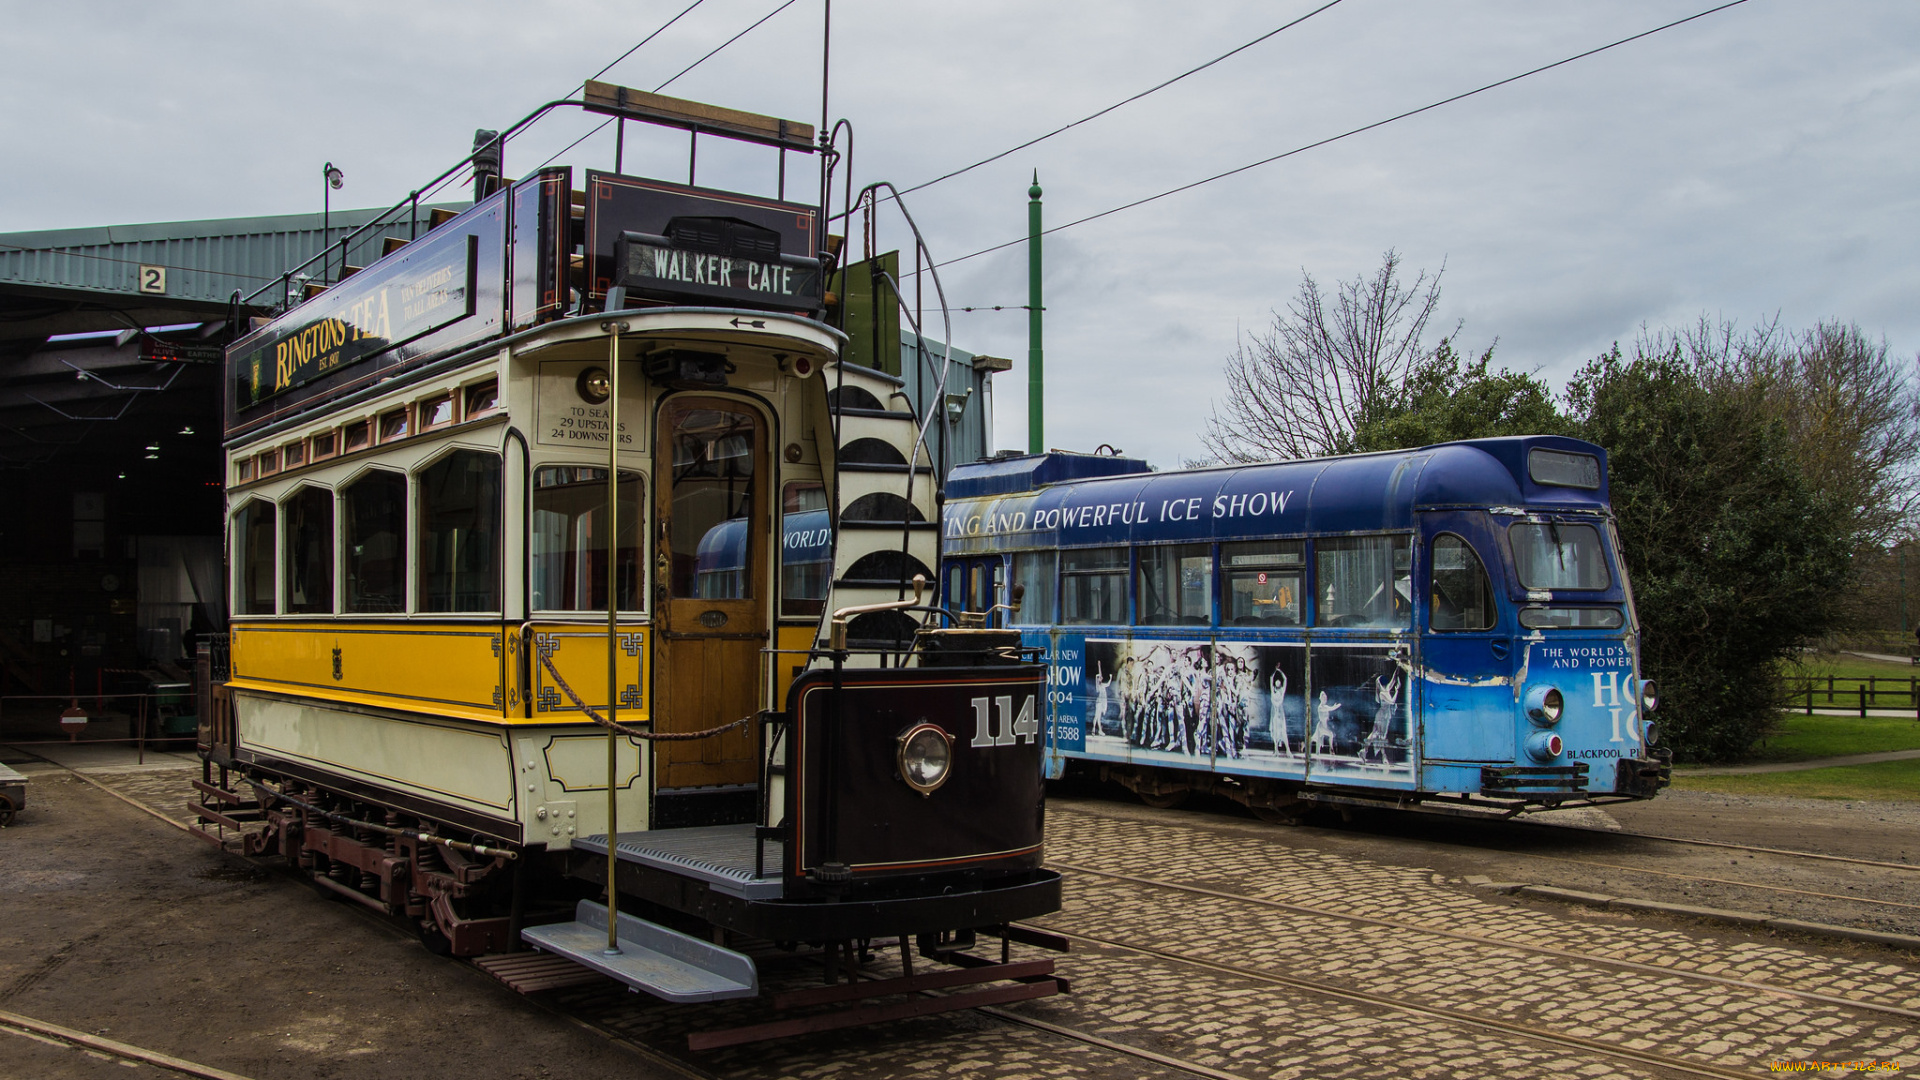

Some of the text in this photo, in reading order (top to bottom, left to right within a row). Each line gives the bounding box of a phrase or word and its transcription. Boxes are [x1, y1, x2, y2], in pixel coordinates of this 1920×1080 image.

[653, 248, 732, 288] WALKER
[145, 269, 161, 290] 2
[415, 265, 452, 297] DELIVERIES
[404, 304, 413, 322] TO
[413, 298, 425, 318] ALL
[274, 286, 393, 393] RINGTONS TEA
[570, 407, 610, 419] TO SEA
[560, 417, 626, 432] 29 UPSTAS
[551, 428, 632, 444] 24 DOWNSTIRS
[943, 490, 1294, 537] ING AND POWERFUL ICE SHOW
[1061, 649, 1079, 660] NEW
[1542, 646, 1624, 658] THE WORLD'S
[1552, 658, 1580, 669] AND
[1048, 691, 1073, 704] 004
[970, 694, 1039, 749] 114
[1058, 715, 1079, 725] ARENA
[1057, 726, 1080, 741] 5588
[1567, 749, 1624, 760] BLACKPOOL
